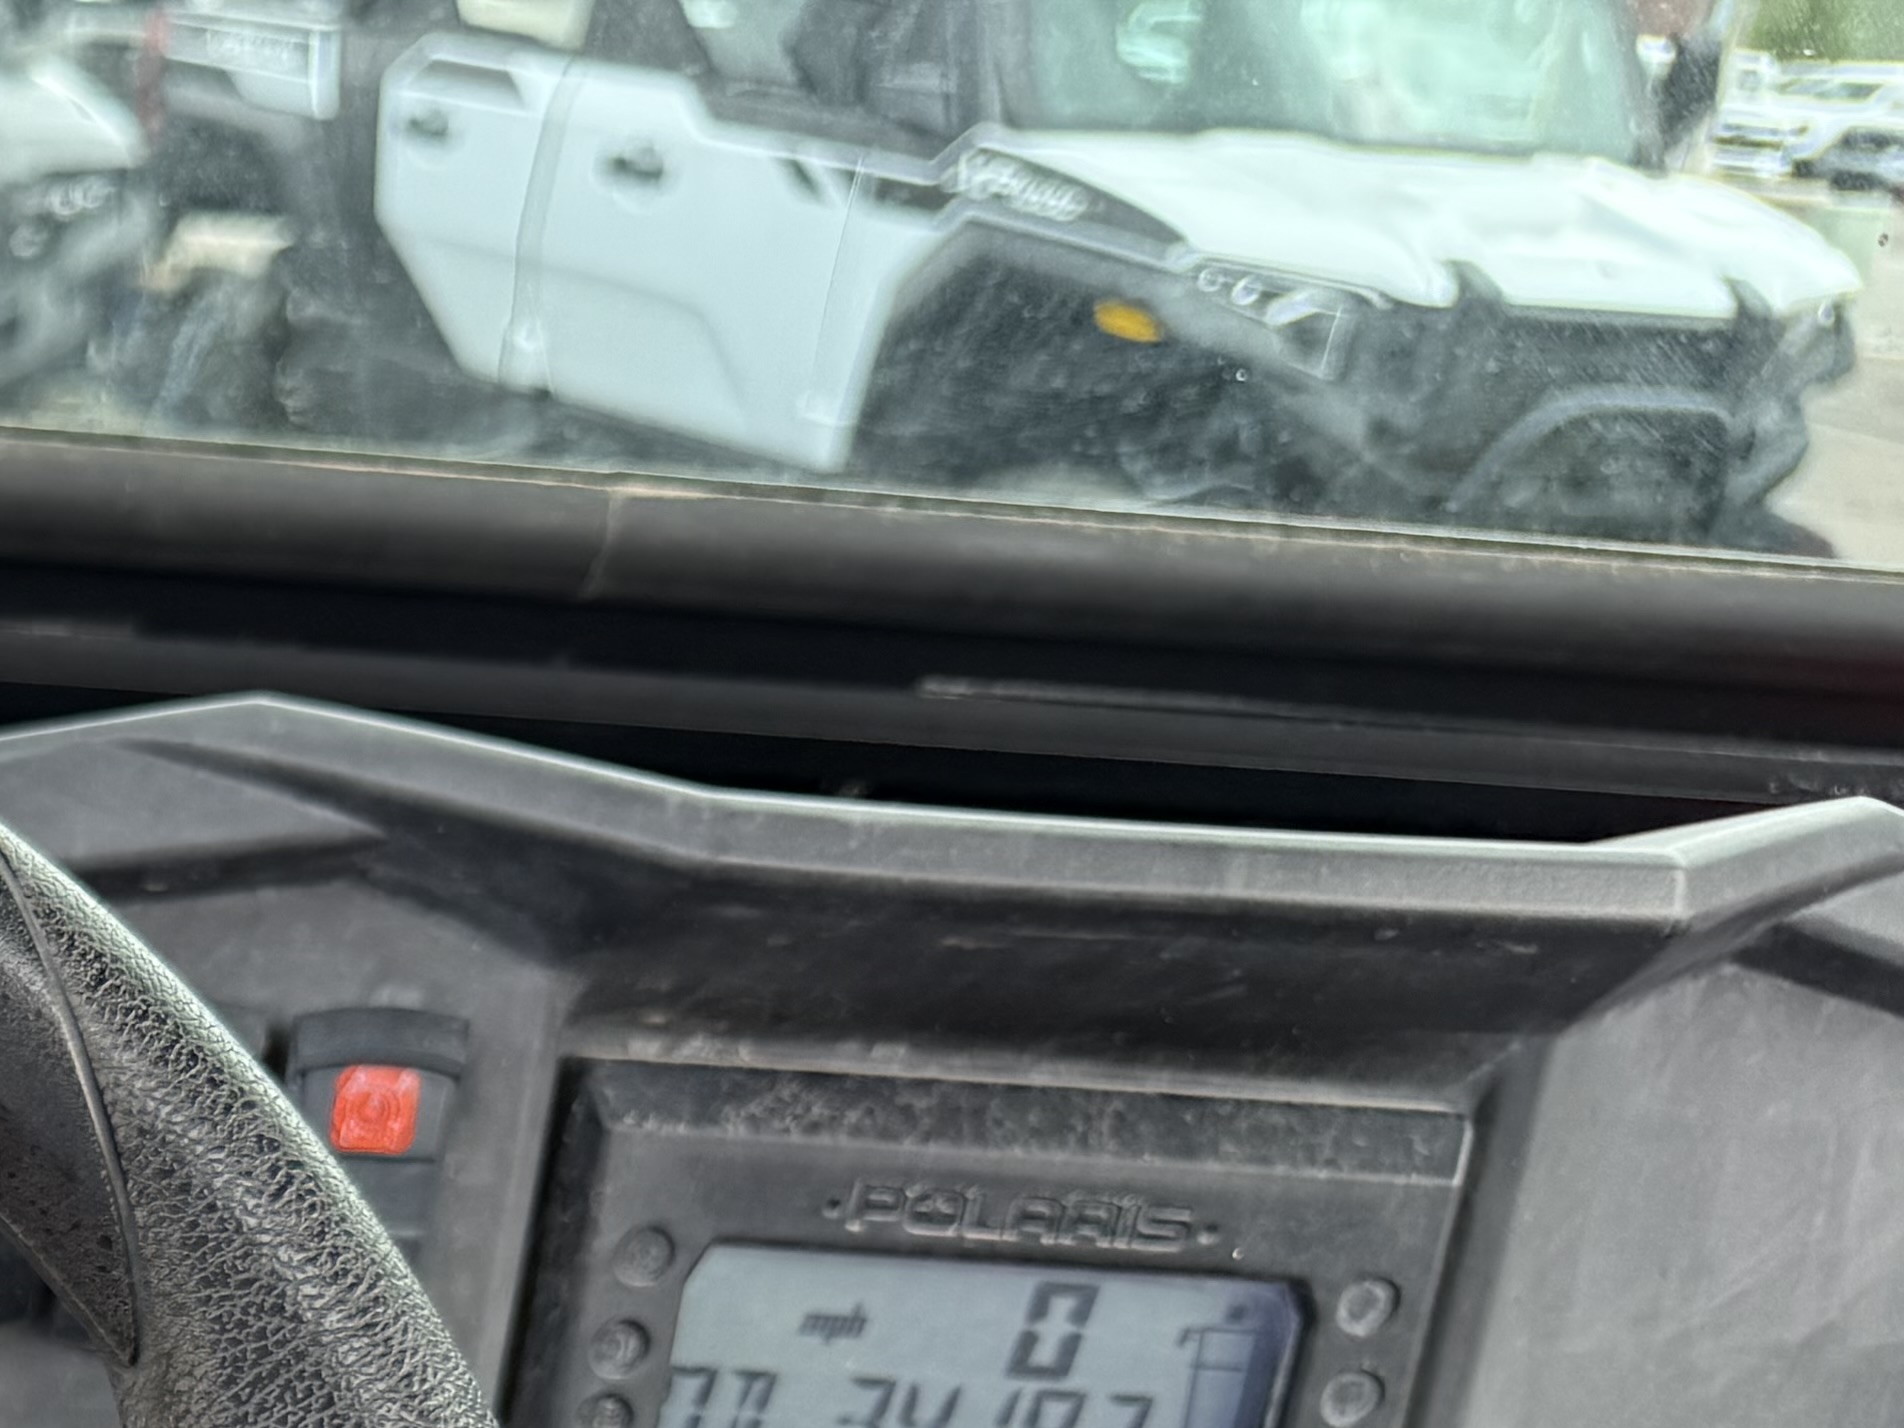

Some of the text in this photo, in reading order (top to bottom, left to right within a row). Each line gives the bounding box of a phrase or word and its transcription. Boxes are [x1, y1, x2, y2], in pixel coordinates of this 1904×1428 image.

[846, 1178, 1192, 1252] POLARIS
[798, 1303, 868, 1344] mph
[1005, 1281, 1099, 1380] 0
